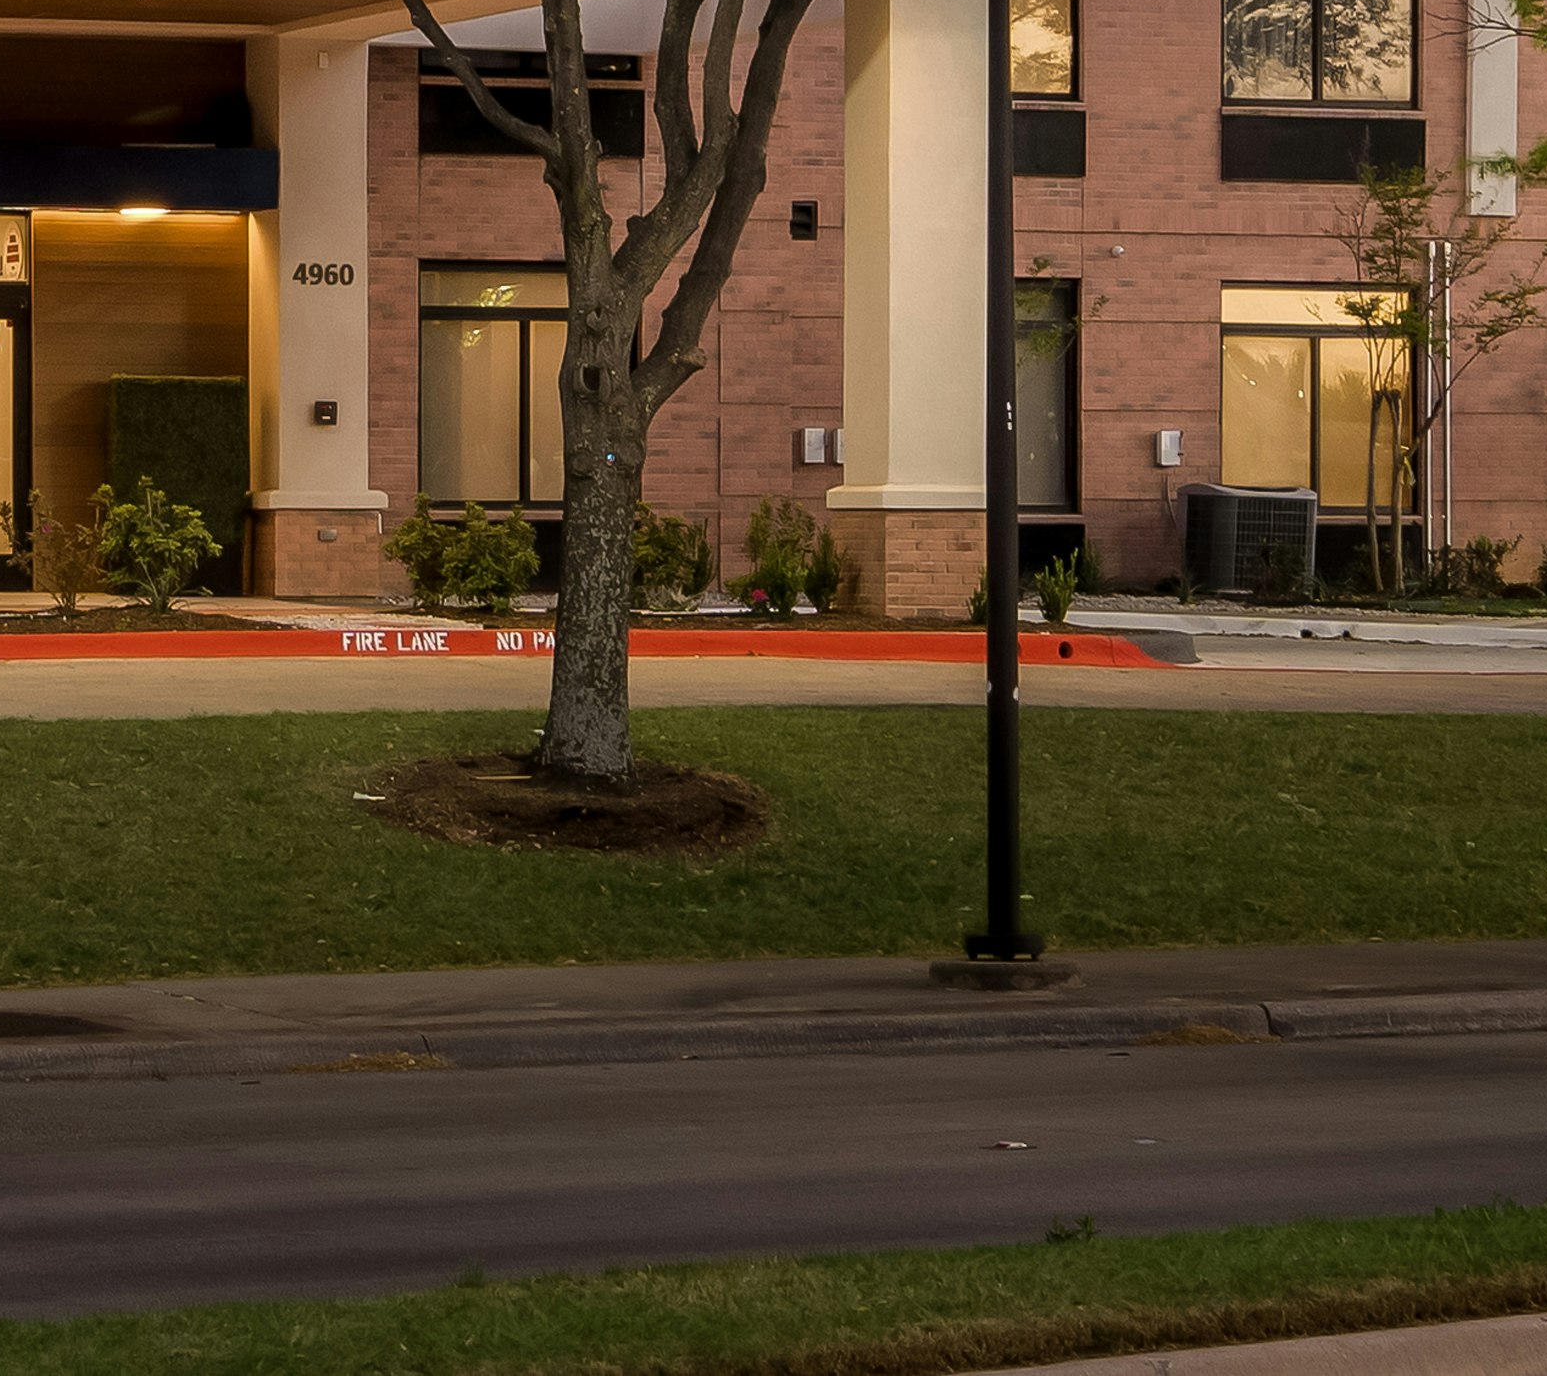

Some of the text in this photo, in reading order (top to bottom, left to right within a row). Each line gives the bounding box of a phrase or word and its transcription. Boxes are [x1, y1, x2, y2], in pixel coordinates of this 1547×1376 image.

[292, 262, 355, 286] 4960
[342, 632, 388, 652] FIRE
[397, 632, 450, 652] LANE
[496, 631, 524, 651] NO
